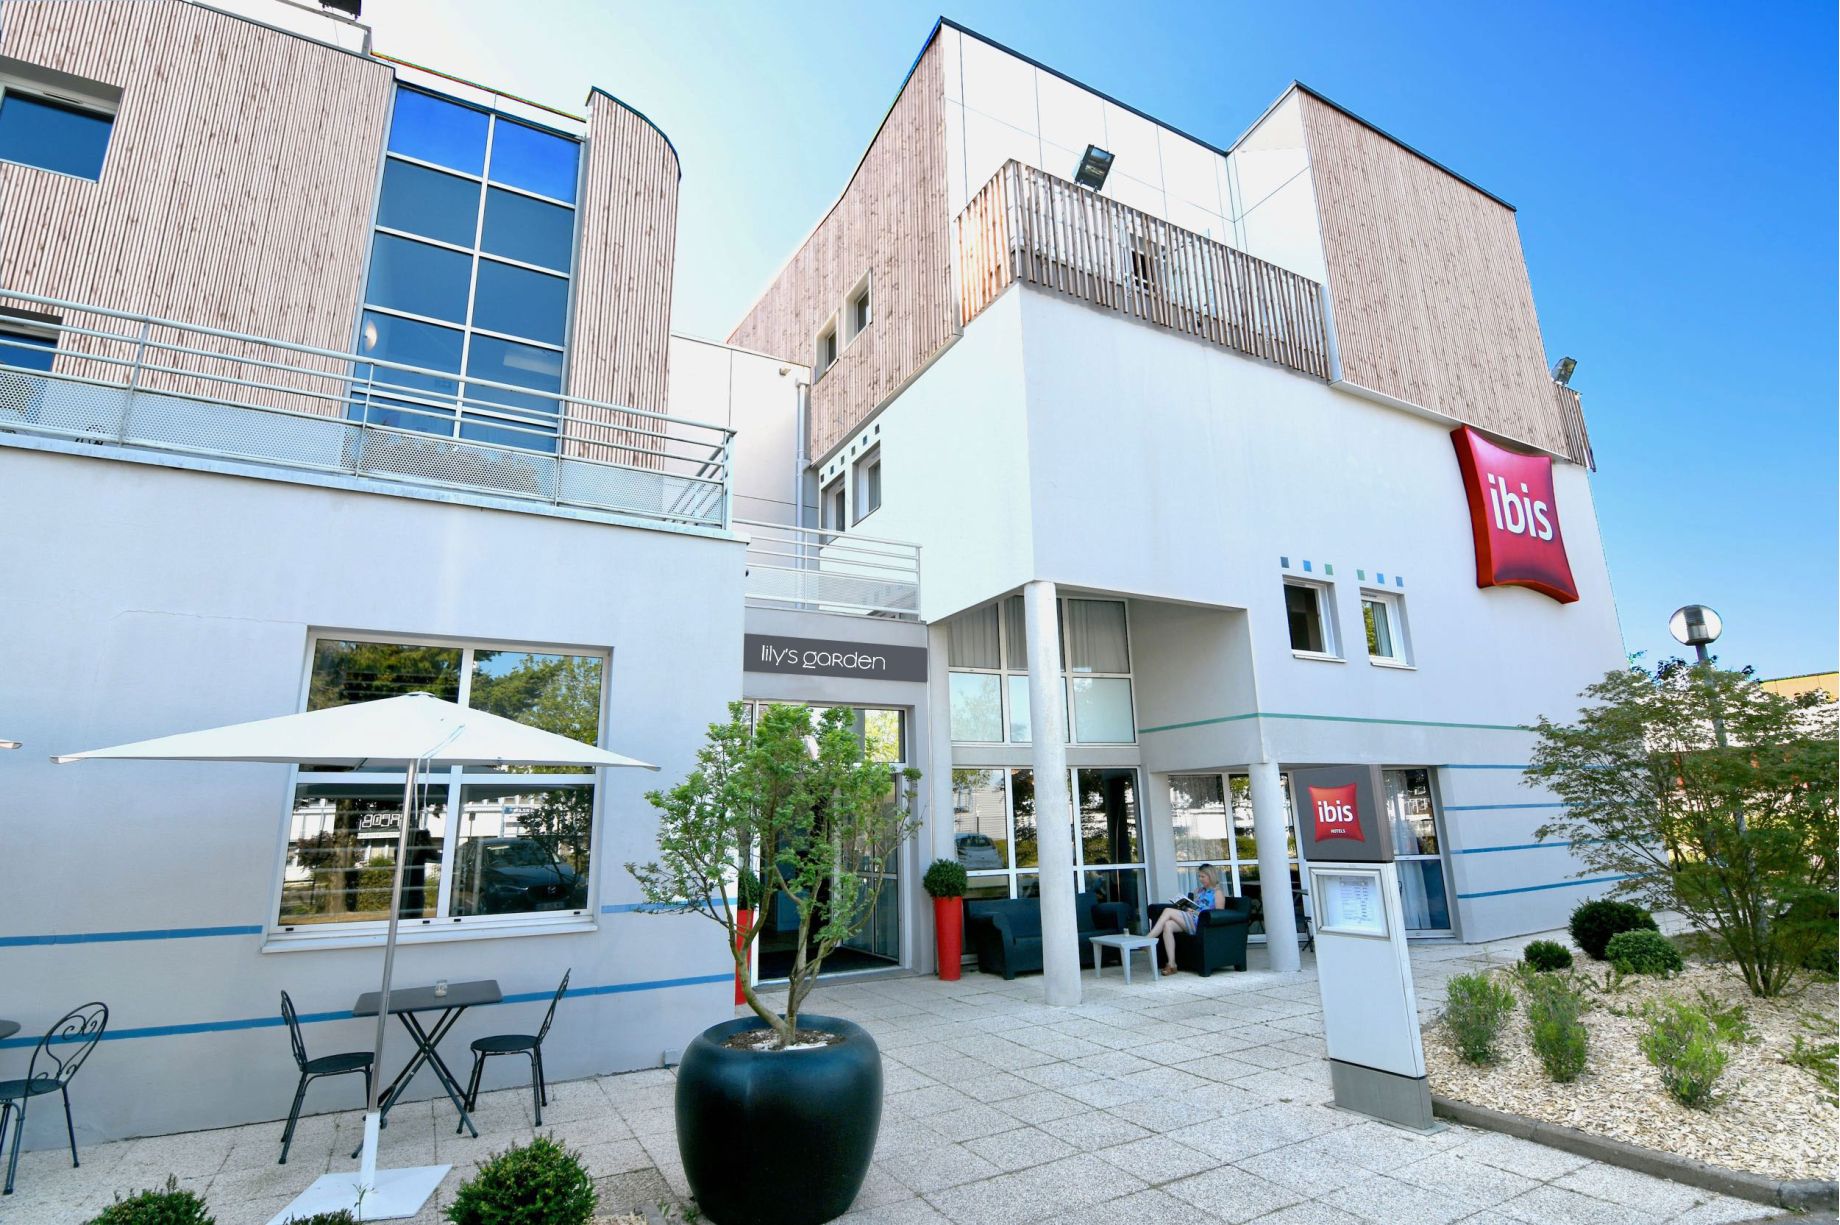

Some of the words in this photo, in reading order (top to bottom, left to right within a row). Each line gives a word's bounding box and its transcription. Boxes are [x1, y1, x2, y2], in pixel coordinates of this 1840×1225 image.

[1487, 473, 1553, 541] ibis
[761, 644, 799, 666] lily's
[802, 651, 886, 670] garden
[1317, 800, 1354, 823] ibis
